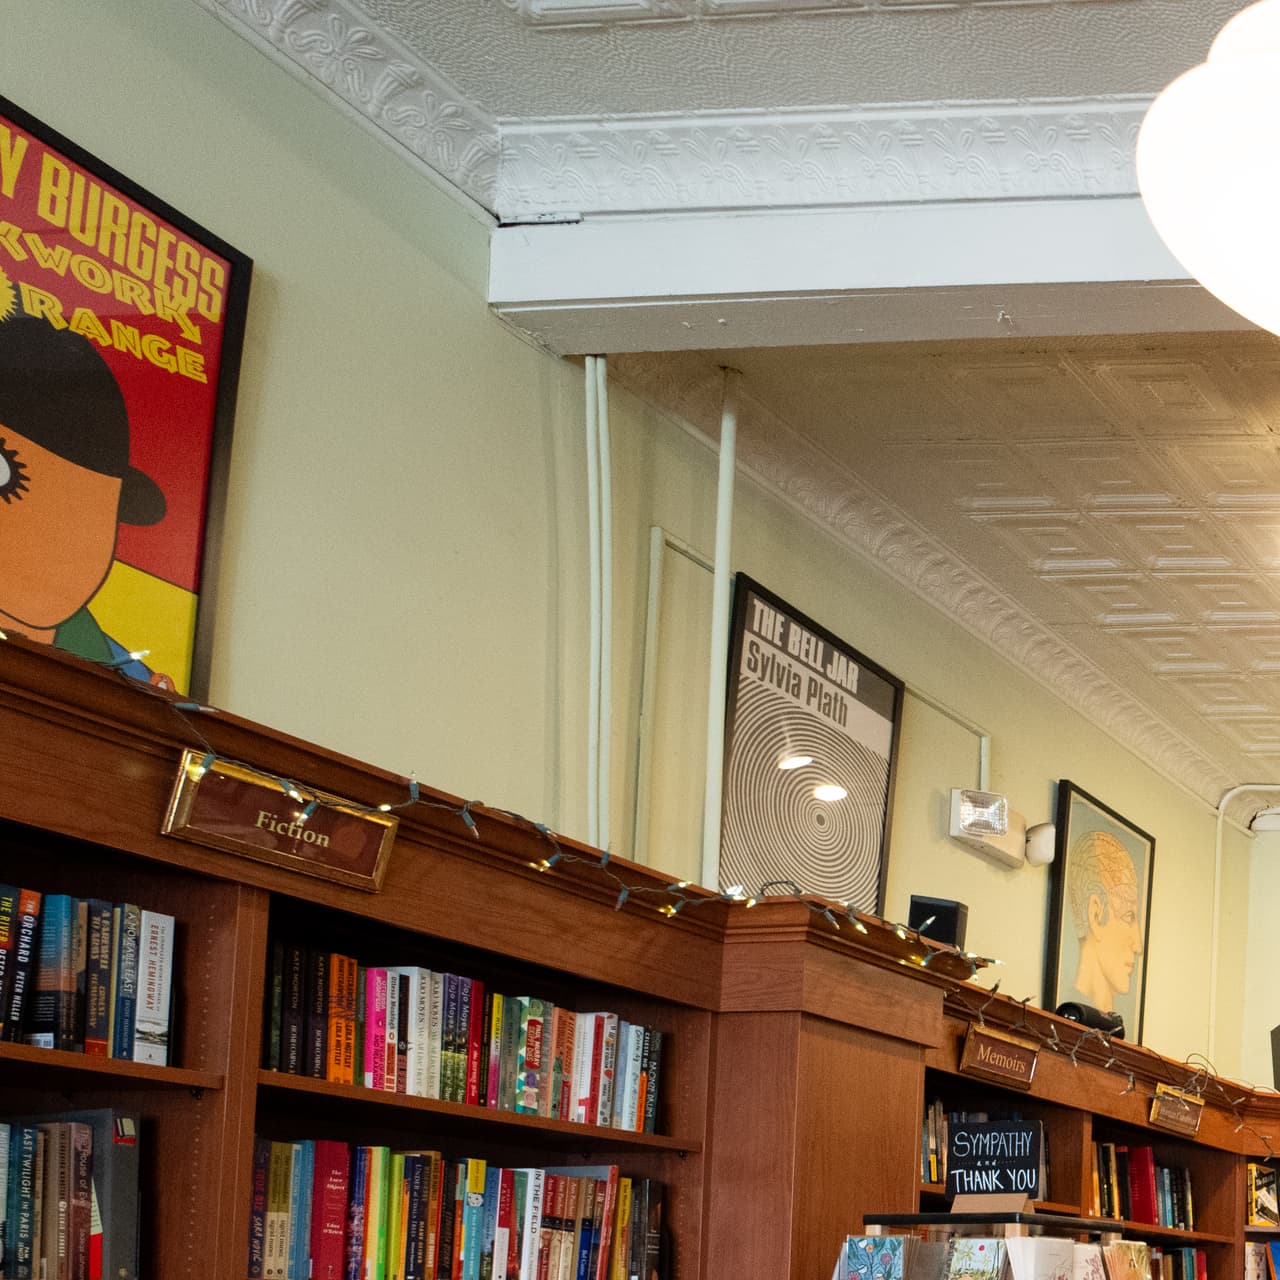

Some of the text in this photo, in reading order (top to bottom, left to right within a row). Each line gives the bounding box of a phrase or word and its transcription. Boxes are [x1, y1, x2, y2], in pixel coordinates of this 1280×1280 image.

[38, 152, 224, 323] BURGESS
[752, 598, 859, 694] THE BELL JAR
[746, 639, 848, 728] Sylvia Plath
[254, 810, 330, 847] Fiction
[977, 1043, 1026, 1073] Memoirs
[953, 1130, 1033, 1157] SYMPATHY
[951, 1168, 1037, 1191] THANK YOU
